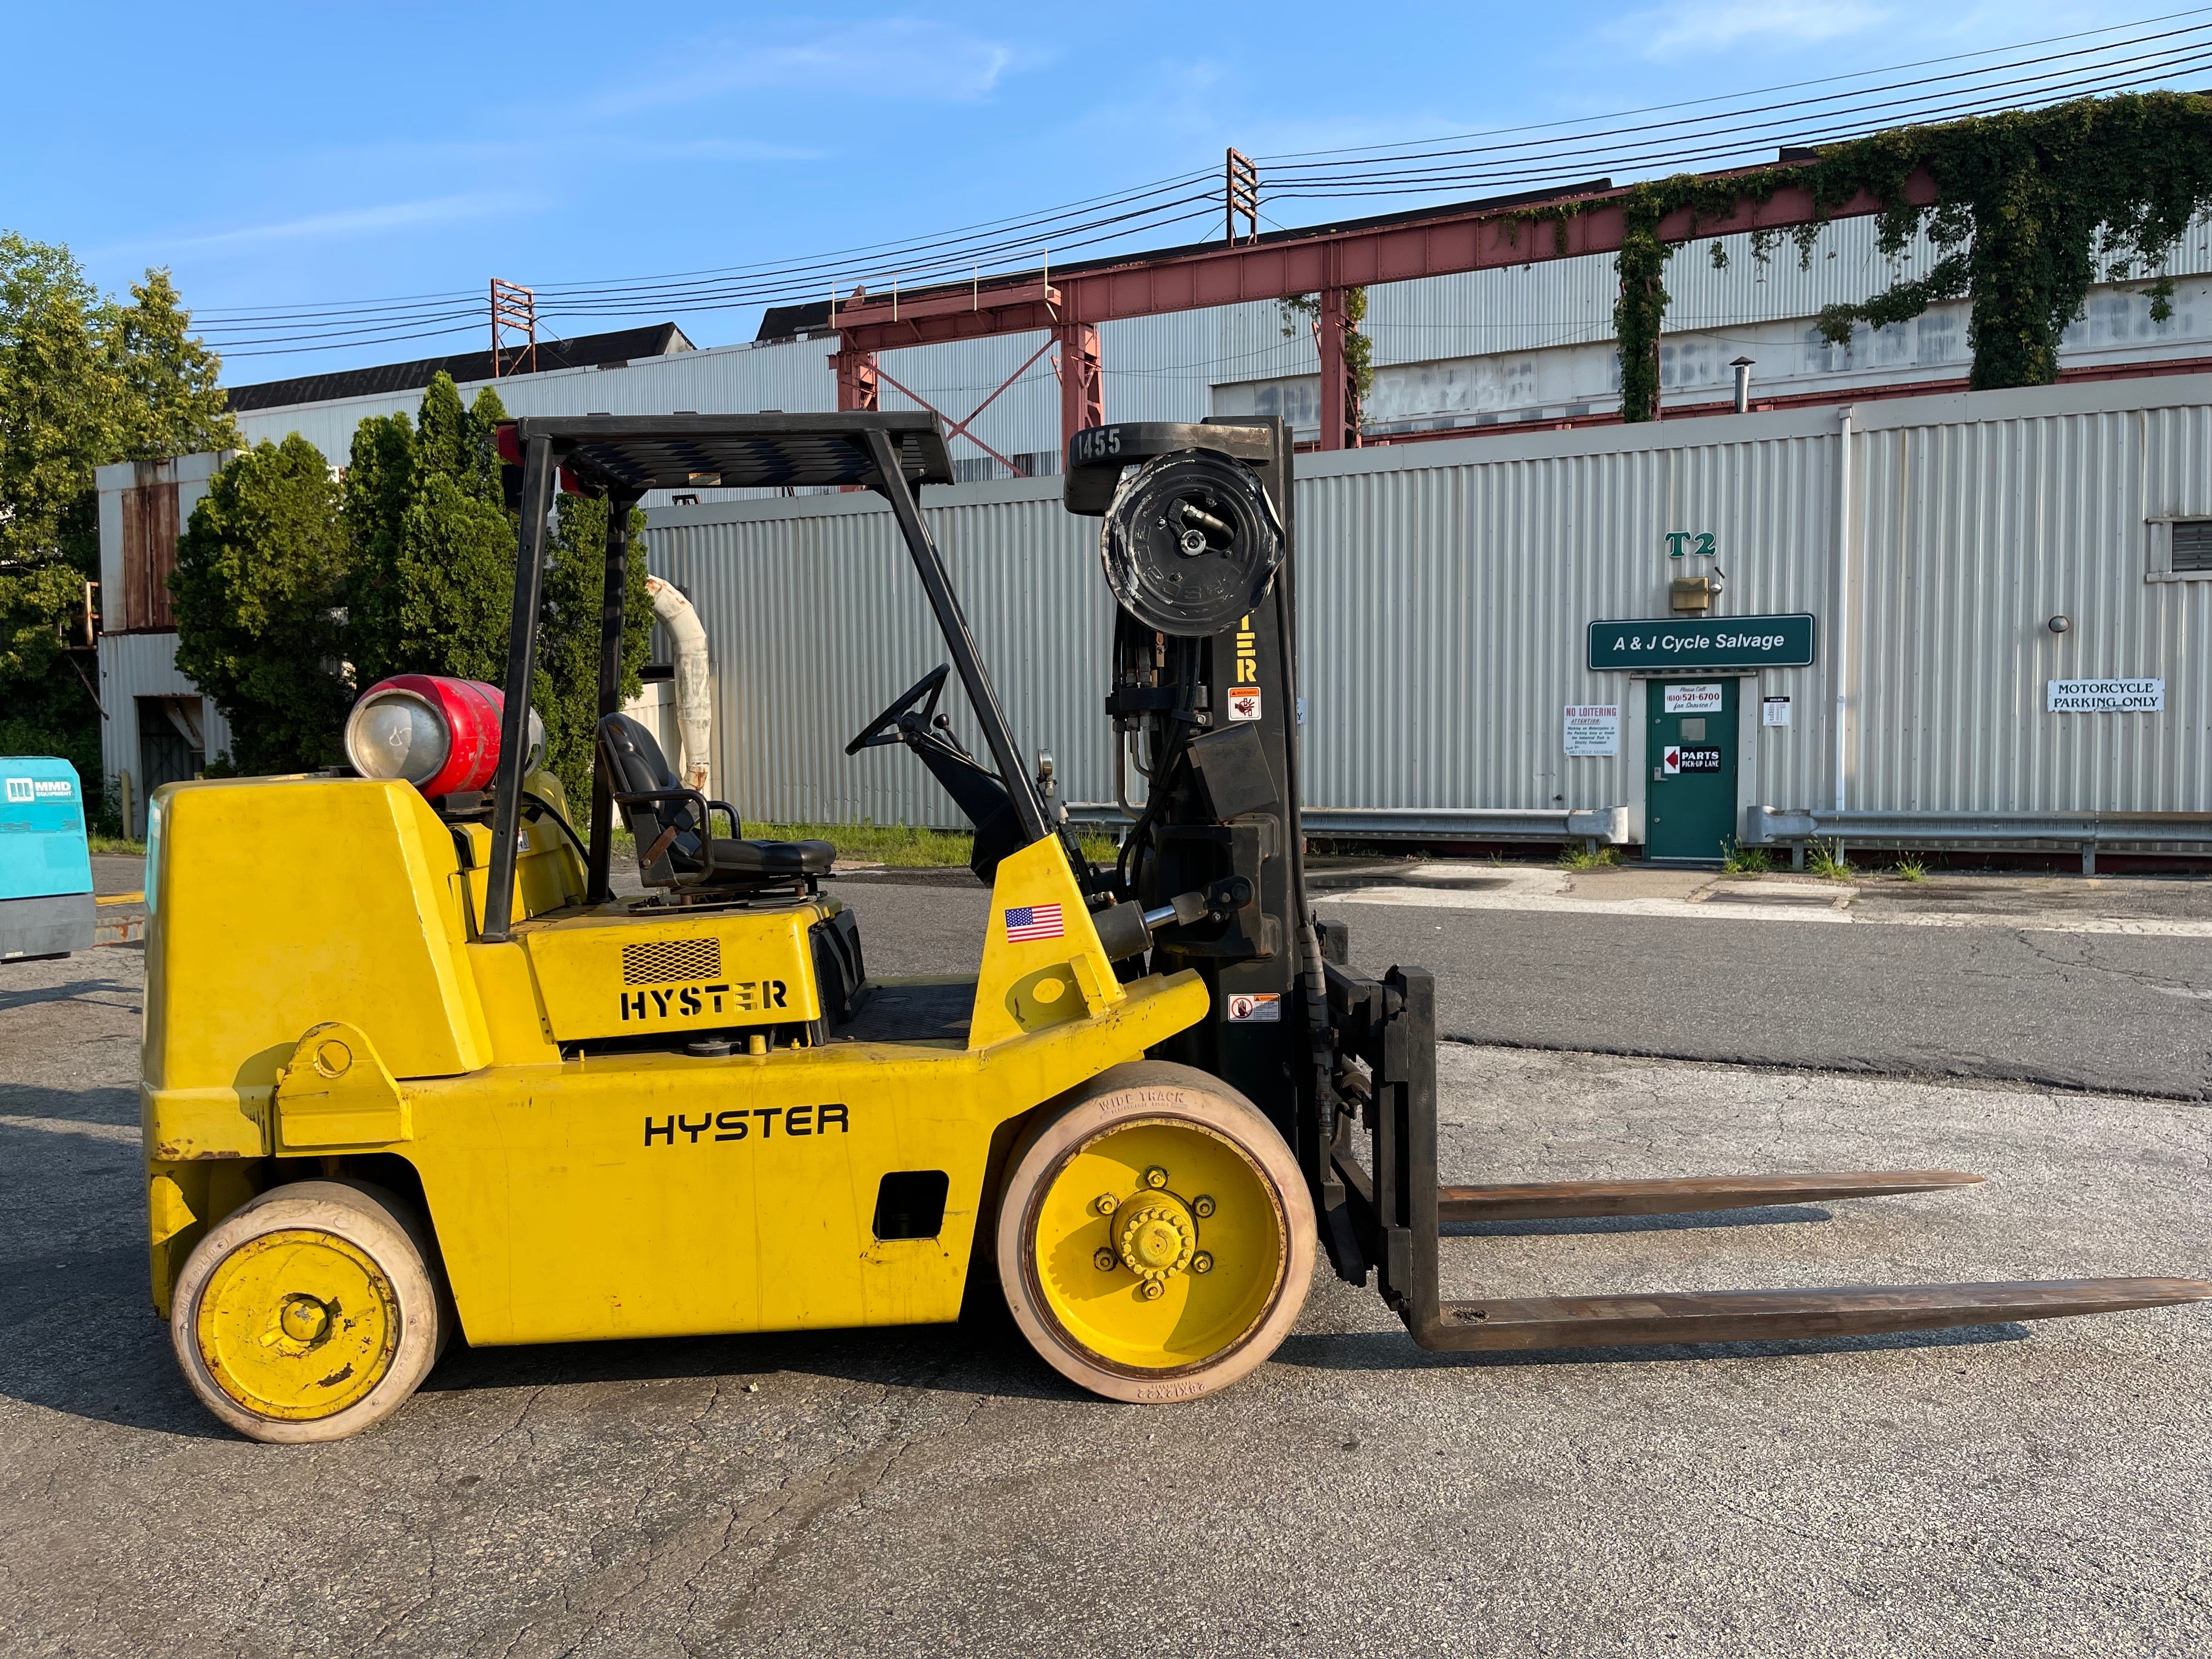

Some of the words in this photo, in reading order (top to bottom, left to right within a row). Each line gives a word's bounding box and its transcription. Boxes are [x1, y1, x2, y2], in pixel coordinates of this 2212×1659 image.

[1079, 428, 1121, 460] 1455
[1613, 636, 1625, 651] A
[1630, 636, 1642, 650] &
[1646, 635, 1657, 650] J
[1662, 634, 1710, 653] Cycle
[1715, 633, 1785, 651] Salvage
[2058, 682, 2154, 694] MOTORCYCLE
[1673, 702, 1684, 711] for
[2054, 697, 2116, 708] PARKING
[2122, 696, 2159, 707] ONLY
[1566, 707, 1576, 717] NO
[1579, 707, 1617, 717] LOITERING
[1681, 751, 1719, 760] PARTS
[35, 781, 71, 792] MMD
[620, 979, 788, 1021] HYSTER
[1099, 1094, 1133, 1111] WIDE
[1139, 1091, 1184, 1103] TRACK
[644, 1103, 849, 1147] HYSTER
